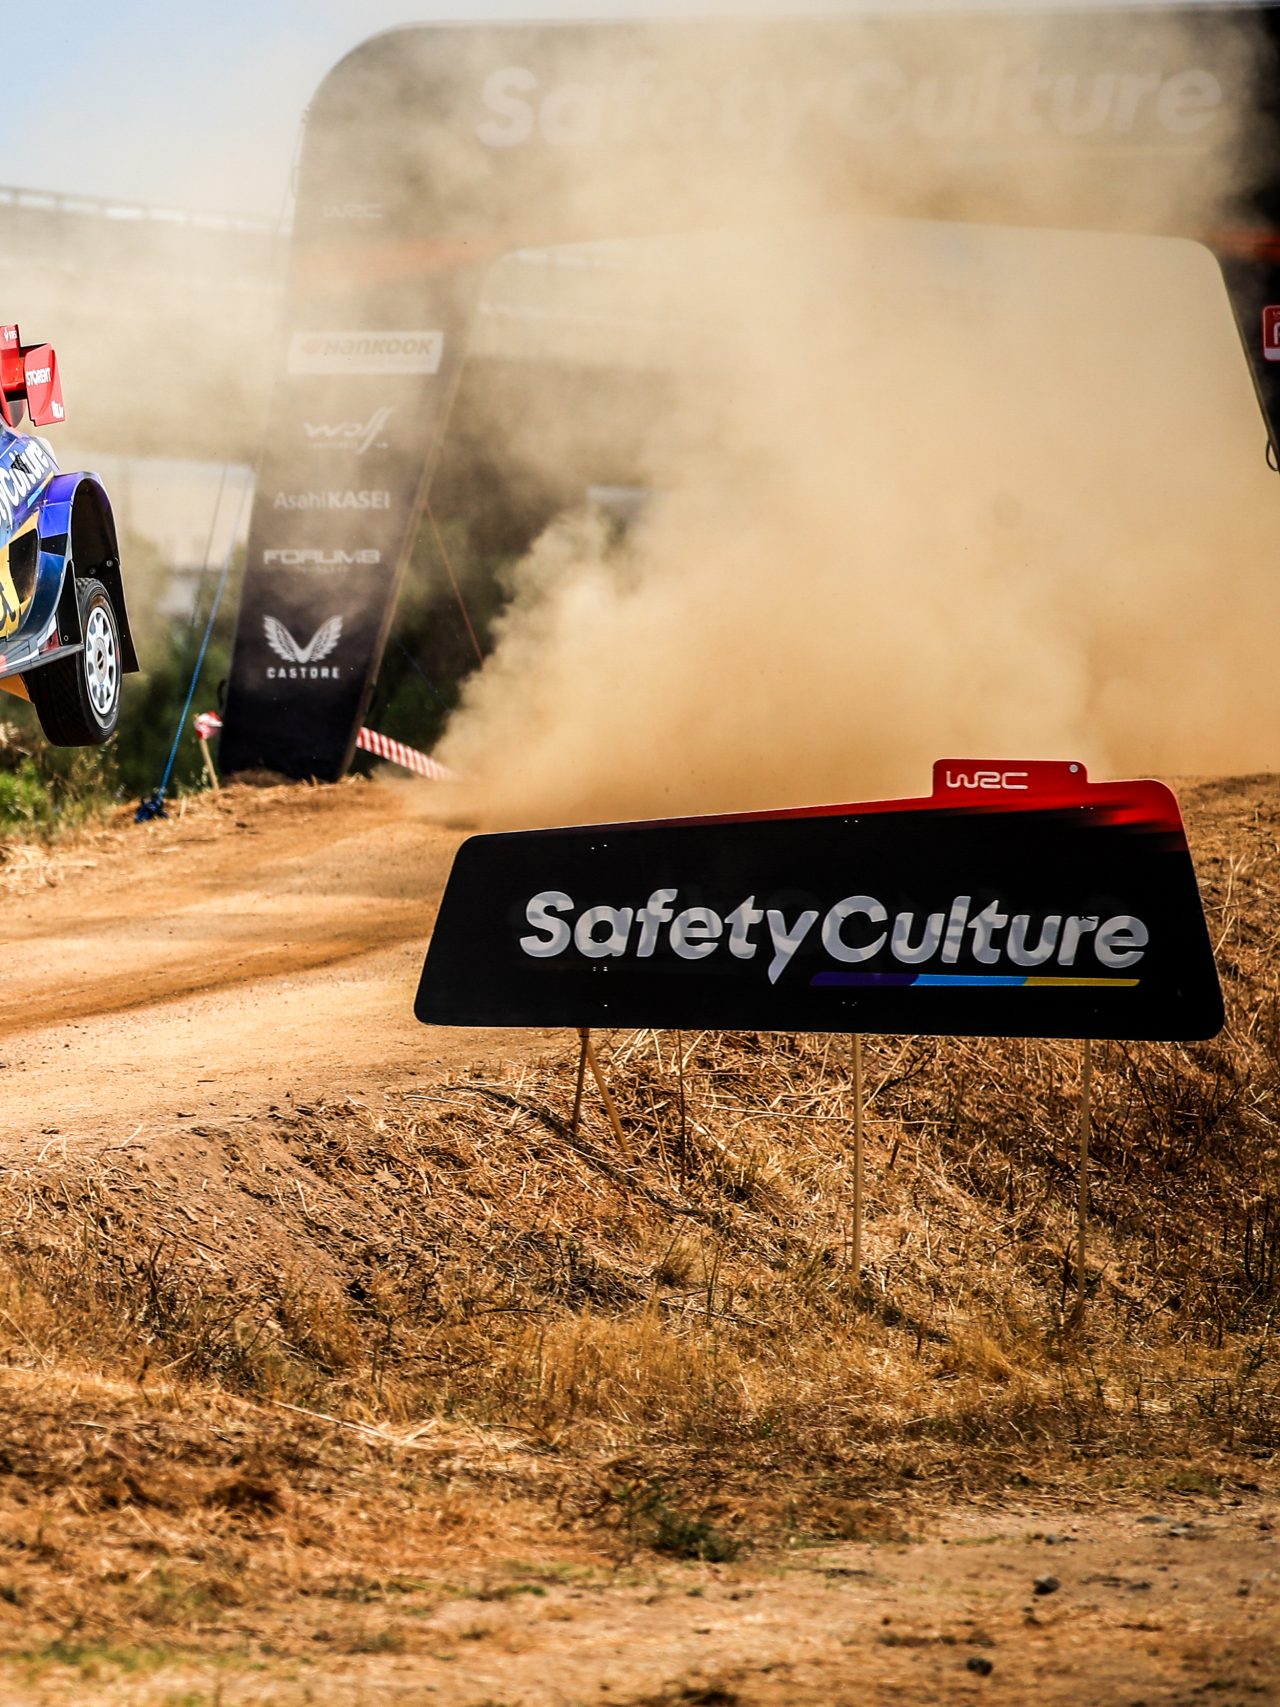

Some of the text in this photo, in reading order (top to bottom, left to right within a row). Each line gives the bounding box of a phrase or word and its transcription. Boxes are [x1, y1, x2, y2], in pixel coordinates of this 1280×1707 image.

[264, 549, 381, 564] FORUM8
[267, 667, 340, 679] CASTORE
[946, 770, 1028, 789] WRC
[519, 888, 1150, 984] SafetyCulture
